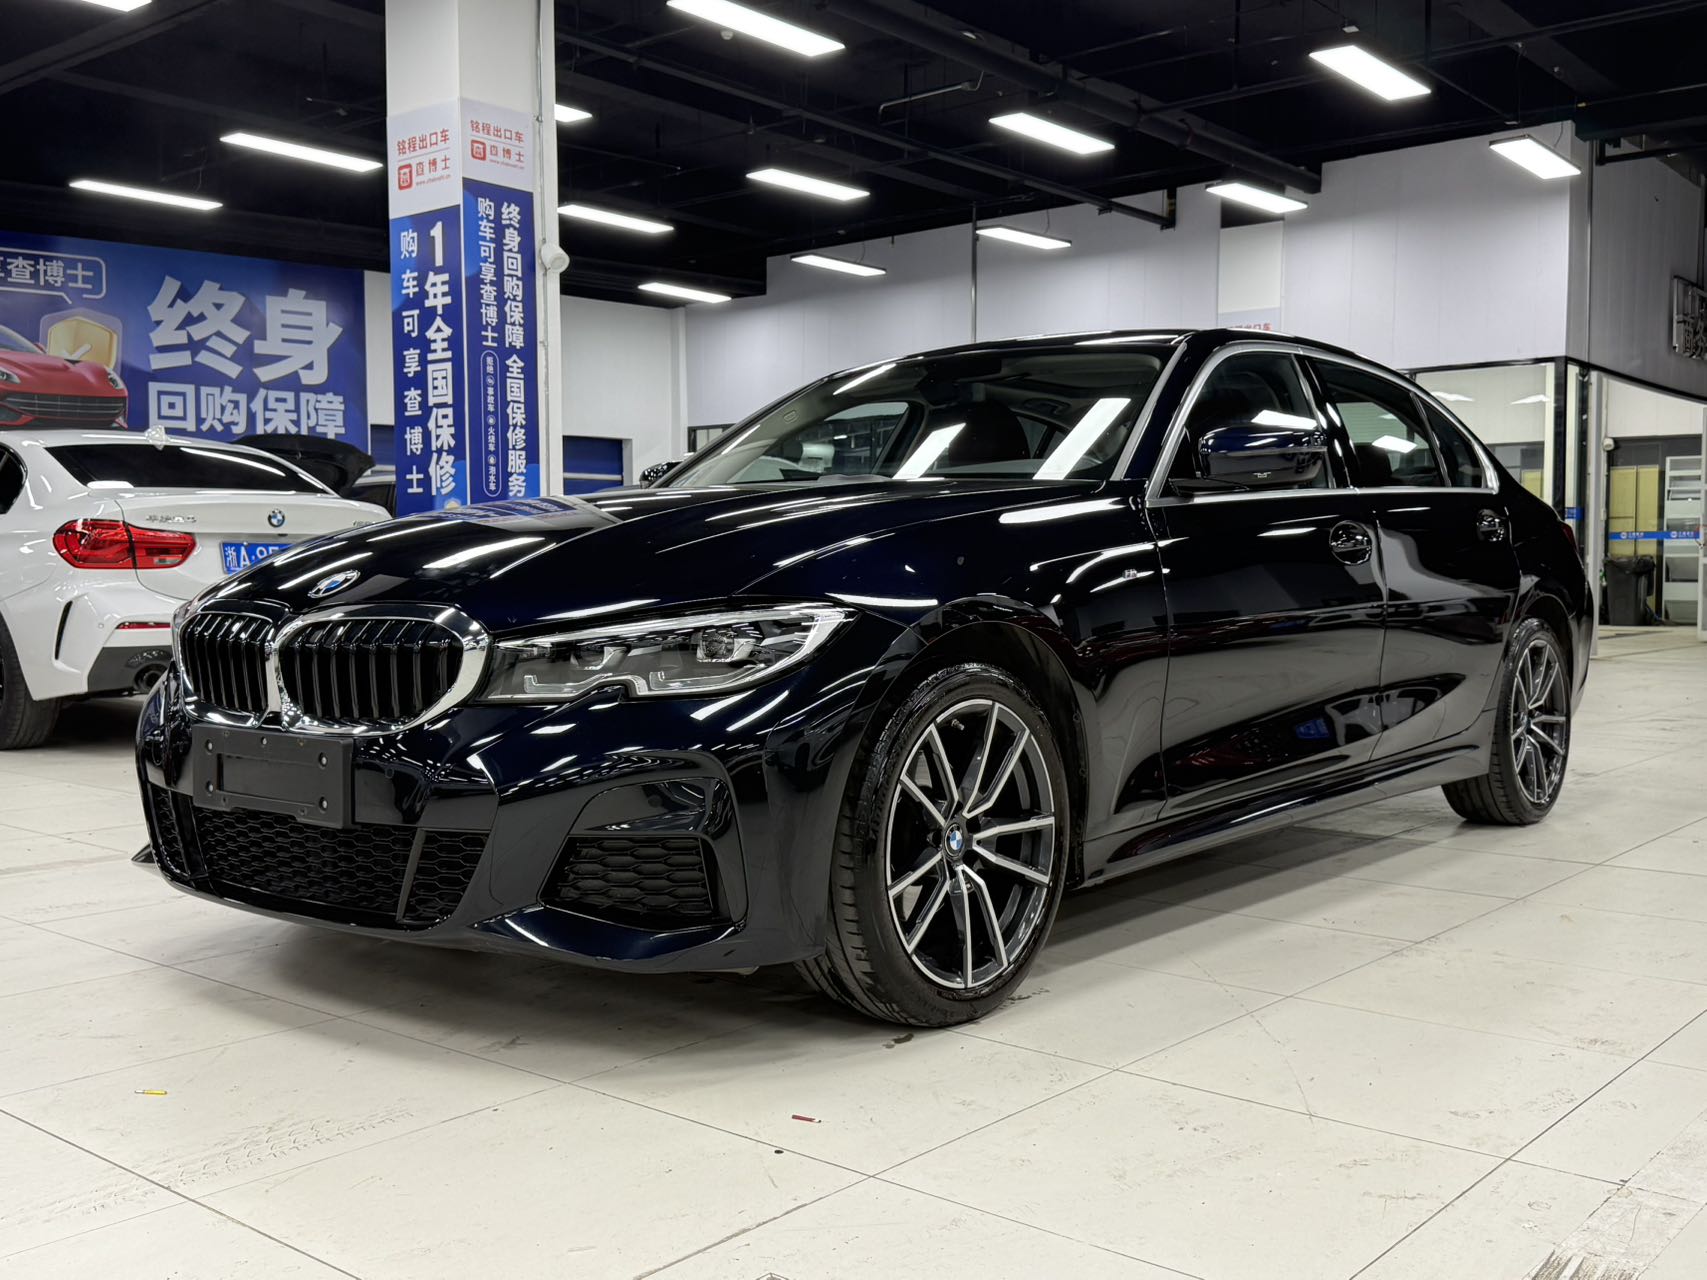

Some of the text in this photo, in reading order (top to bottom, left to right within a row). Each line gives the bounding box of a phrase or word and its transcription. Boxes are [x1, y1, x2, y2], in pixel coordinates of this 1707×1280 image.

[397, 128, 450, 156] 铭程出口车
[470, 119, 525, 144] 铭程出口车
[0, 256, 94, 289] 查博士
[147, 275, 344, 386] 终身
[477, 197, 499, 347] 购车可享查博士
[501, 201, 525, 350] 终身回购保障
[148, 381, 347, 440] 回购保障
[400, 229, 425, 494] 购车可享查博士
[424, 221, 456, 496] 1年全国保修
[505, 353, 527, 498] 全国保修服务
